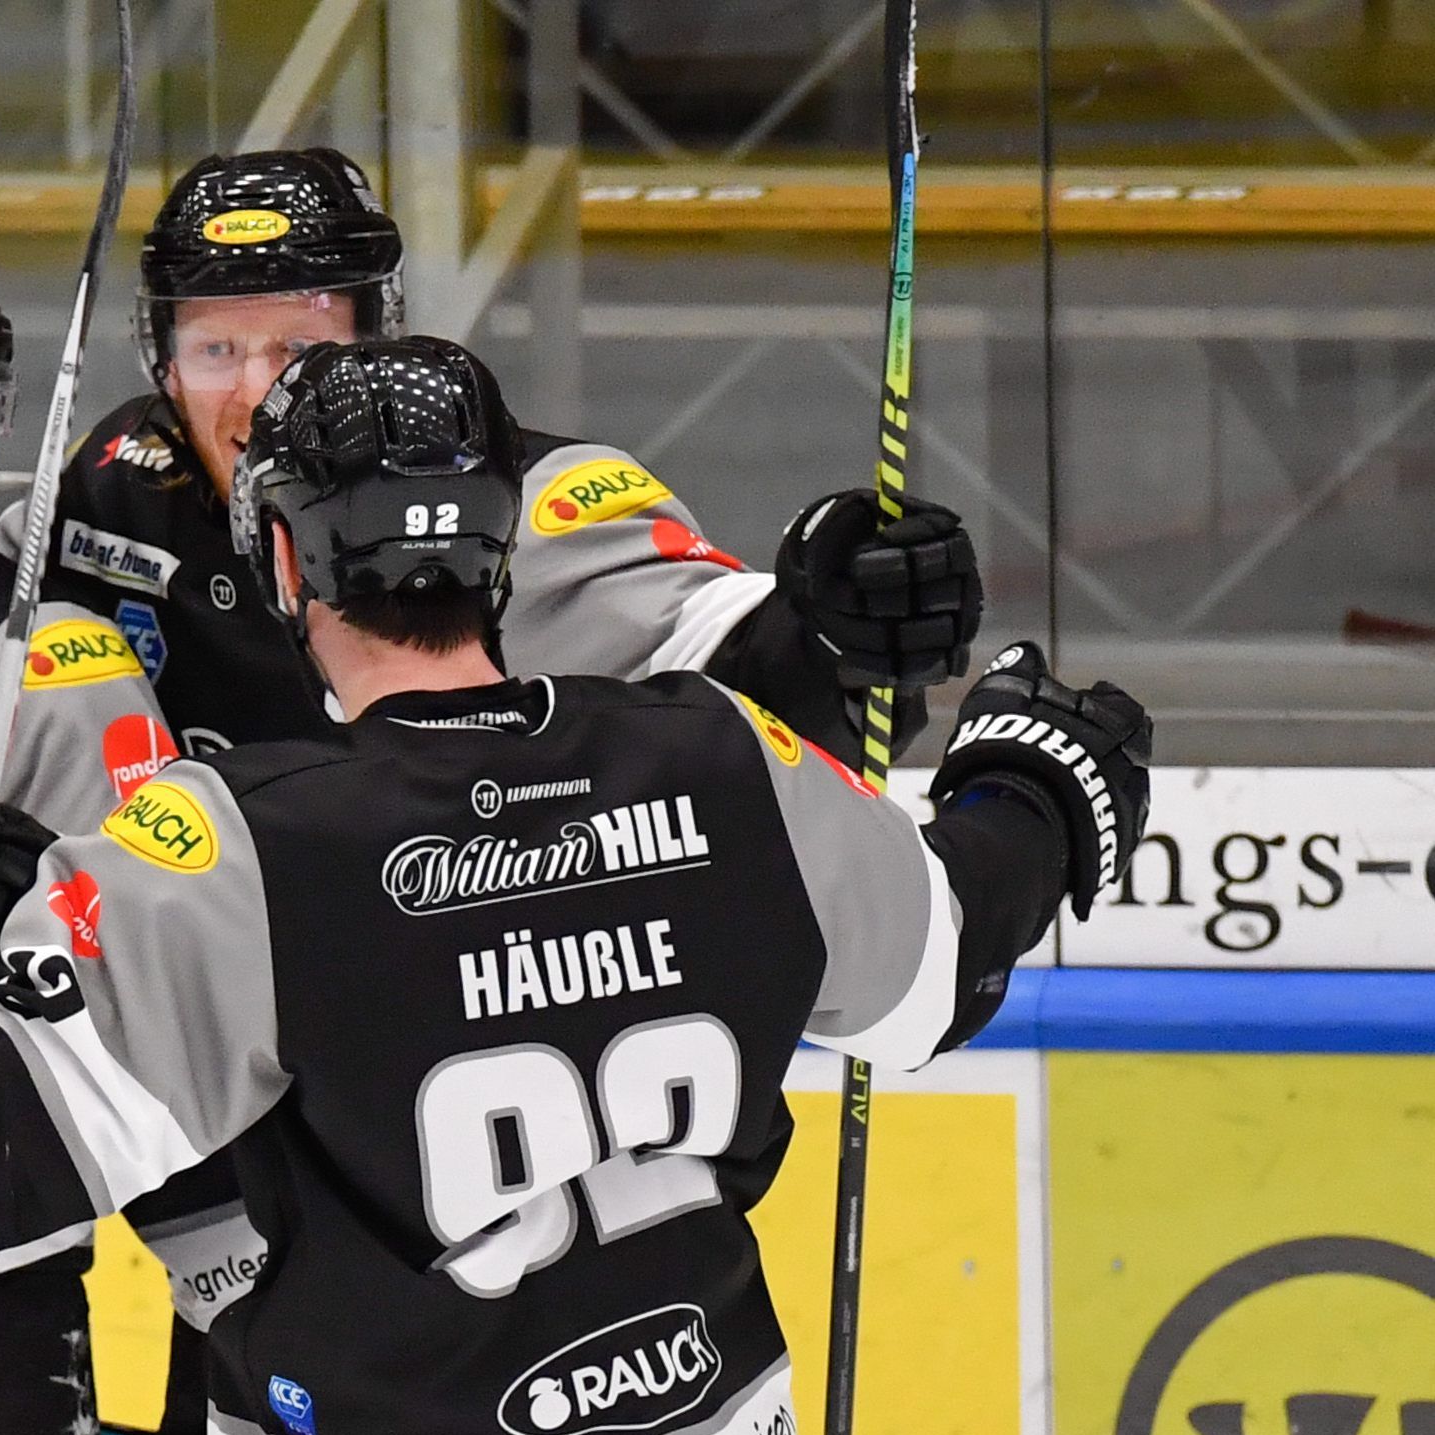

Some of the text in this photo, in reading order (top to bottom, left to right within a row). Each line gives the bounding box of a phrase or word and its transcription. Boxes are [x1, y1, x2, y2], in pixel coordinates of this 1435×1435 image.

[405, 503, 460, 536] 92
[567, 470, 651, 510] RAUC
[48, 633, 128, 668] RAUC
[505, 777, 592, 804] WARRIOR
[947, 713, 1117, 889] WARRIOR
[118, 795, 204, 861] RAUCH
[381, 795, 710, 916] William HILL
[1108, 832, 1435, 953] ngs-
[851, 1058, 869, 1125] ALP
[414, 1012, 743, 1299] 92
[271, 1381, 306, 1410] ICE
[571, 1319, 716, 1419] RAUCH
